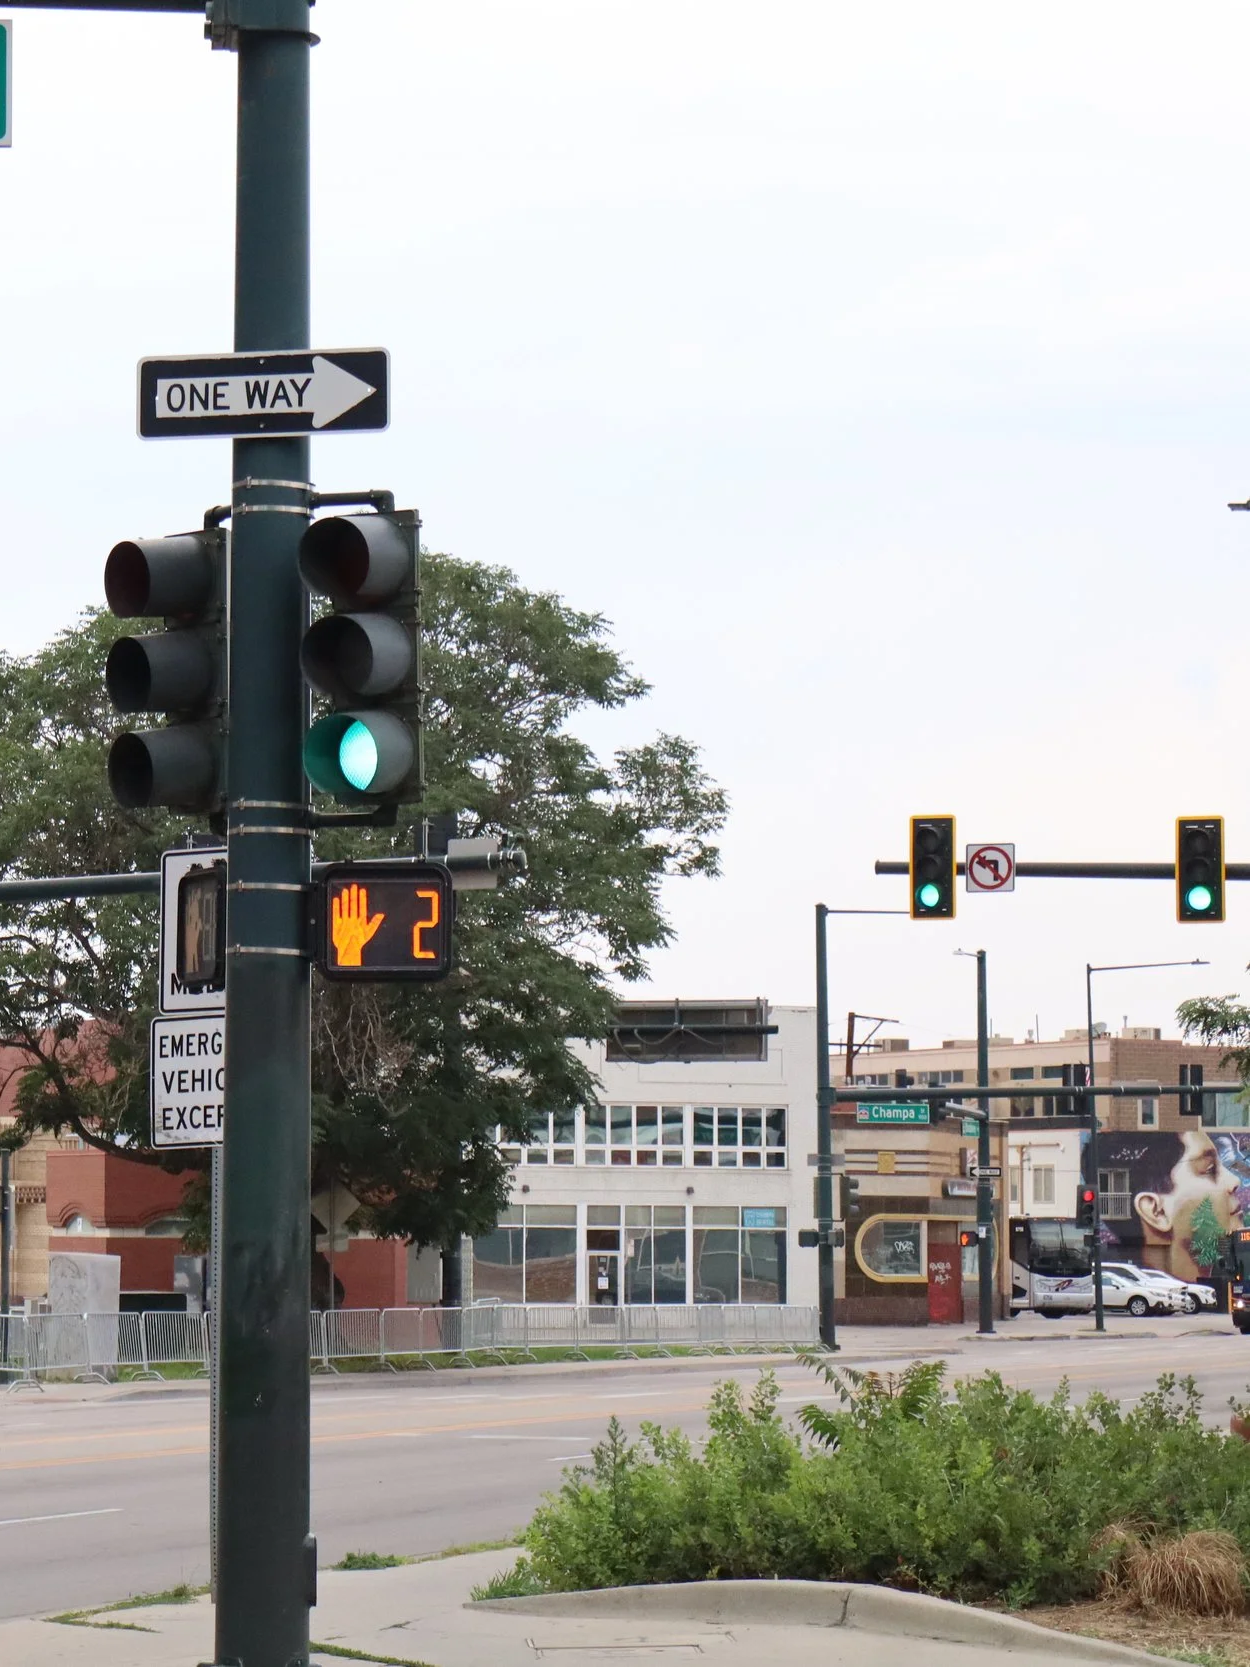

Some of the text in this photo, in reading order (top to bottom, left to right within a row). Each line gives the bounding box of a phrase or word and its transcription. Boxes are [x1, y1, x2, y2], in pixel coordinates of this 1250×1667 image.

[166, 377, 312, 413] ONE WAY
[412, 890, 439, 959] 2
[159, 1032, 223, 1059] EMERG
[162, 1068, 225, 1094] VEHIC
[872, 1106, 915, 1120] Champa
